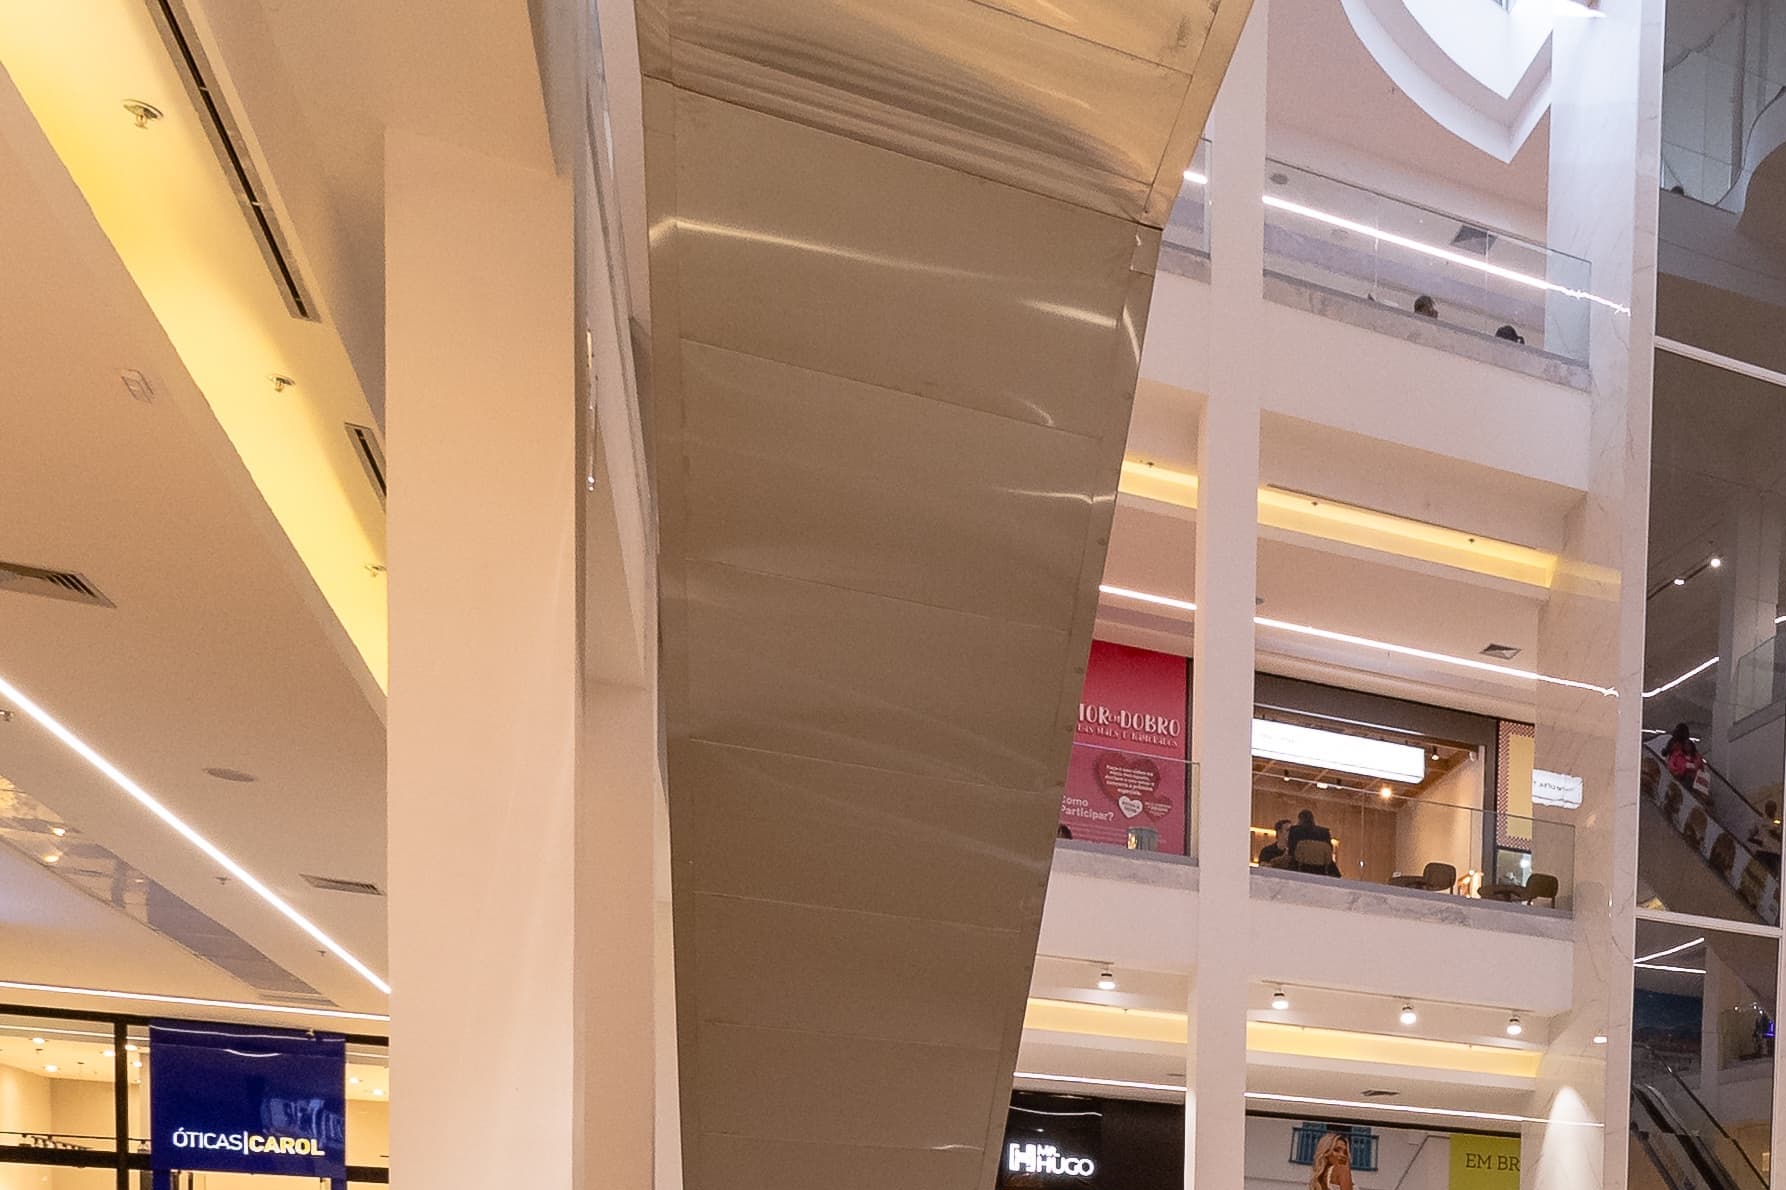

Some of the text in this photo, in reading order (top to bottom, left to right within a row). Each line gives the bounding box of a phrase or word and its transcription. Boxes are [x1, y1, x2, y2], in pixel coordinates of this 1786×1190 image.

[1120, 710, 1181, 737] DOBRO
[1037, 1156, 1095, 1176] HUGO
[1465, 1152, 1492, 1170] EM
